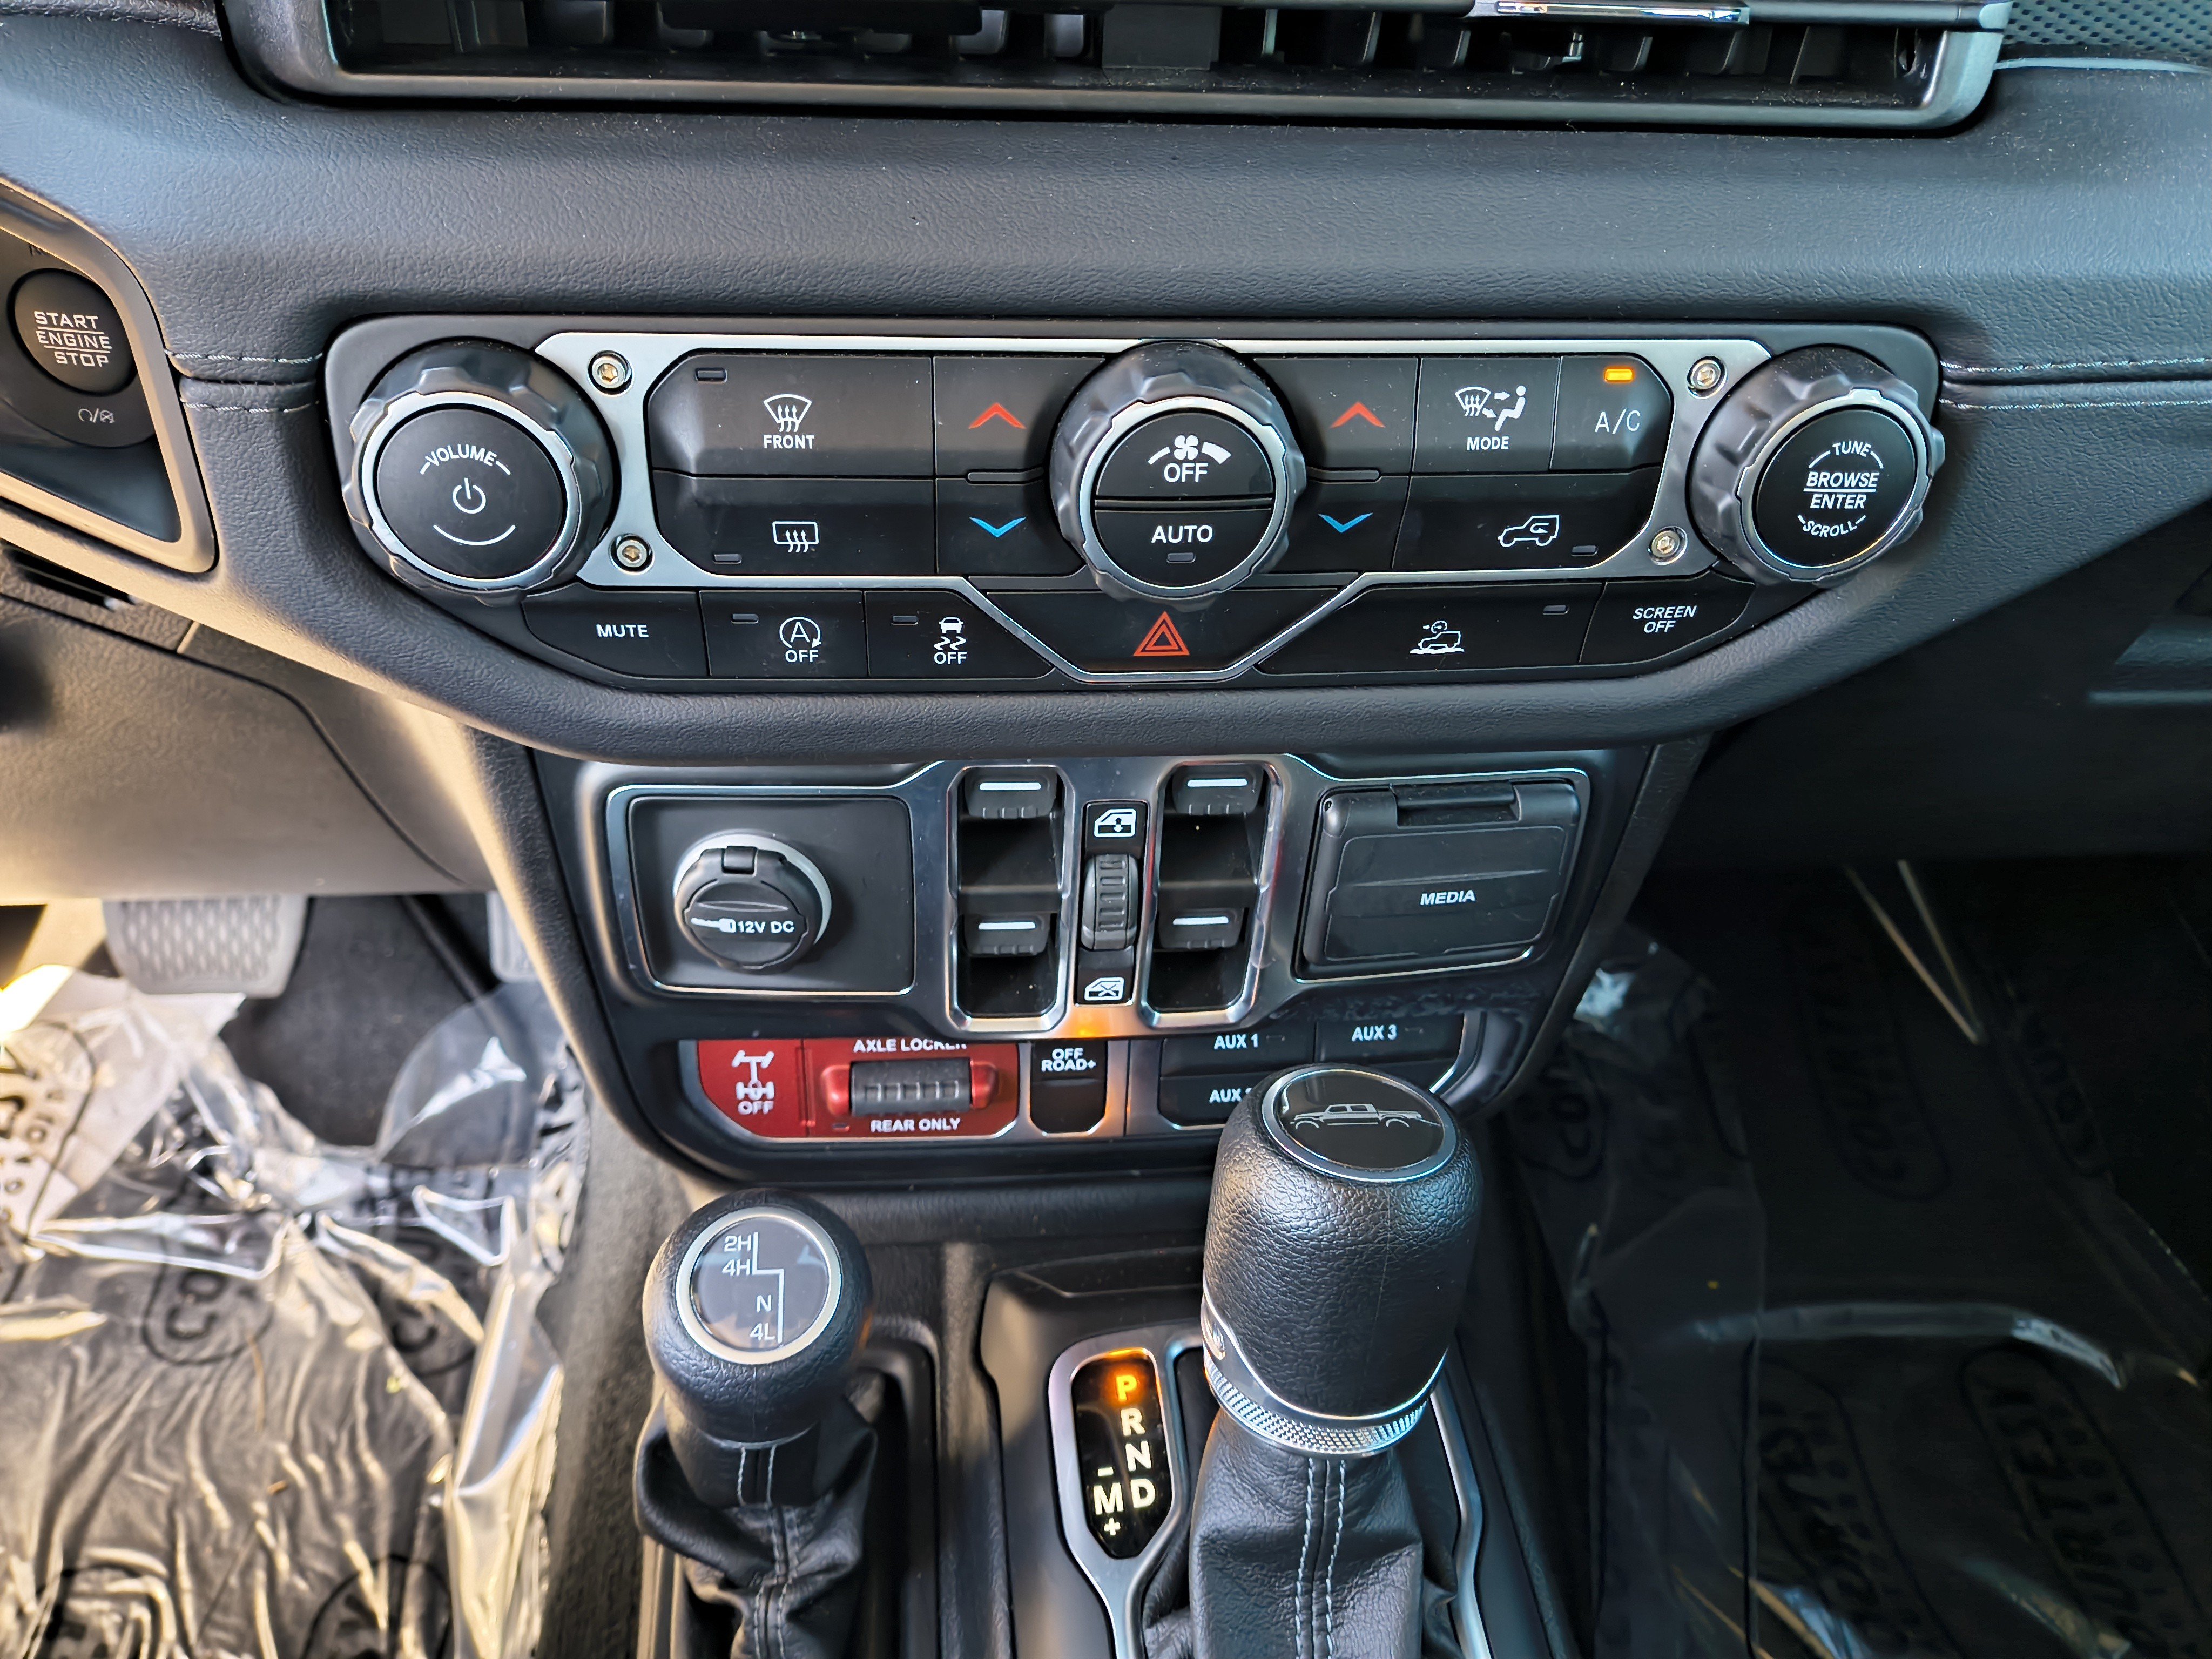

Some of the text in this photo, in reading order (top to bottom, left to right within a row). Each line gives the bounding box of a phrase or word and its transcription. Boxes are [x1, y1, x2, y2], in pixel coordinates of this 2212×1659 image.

[34, 311, 98, 329] START
[36, 331, 112, 349] ENGINE
[54, 351, 109, 367] STOP
[1595, 408, 1640, 434] A/C
[764, 435, 814, 449] FRONT
[1467, 436, 1509, 450] MODE
[1832, 441, 1872, 457] TUNE
[425, 444, 497, 466] VOLUME
[1164, 463, 1208, 482] OFF
[1806, 471, 1879, 488] BROWSE
[1810, 494, 1867, 509] ENTER
[1151, 525, 1212, 543] AUTO
[1803, 520, 1857, 537] SCROLL
[1633, 606, 1697, 619] SCREEN
[596, 624, 649, 637] MUTE
[1644, 621, 1676, 633] OFF
[785, 650, 818, 662] OFF
[934, 652, 967, 664] OFF
[1420, 890, 1475, 905] MEDIA
[738, 921, 794, 933] 12V DC
[1352, 1024, 1397, 1041] AUX 3
[853, 1039, 896, 1053] AXLE
[1214, 1034, 1258, 1049] AUX 1
[1052, 1048, 1084, 1060] OFF
[1042, 1059, 1096, 1071] ROAD+
[1209, 1089, 1242, 1103] AUX
[738, 1101, 773, 1114] OFF
[871, 1118, 960, 1132] REAR ONLY
[724, 1235, 751, 1252] 2H
[722, 1259, 750, 1276] 4H
[757, 1295, 771, 1312] N
[750, 1323, 775, 1341] 4L
[1116, 1374, 1137, 1401] P
[1121, 1407, 1145, 1436] R
[1125, 1441, 1151, 1471] N
[1093, 1482, 1124, 1515] M
[1130, 1479, 1155, 1508] D
